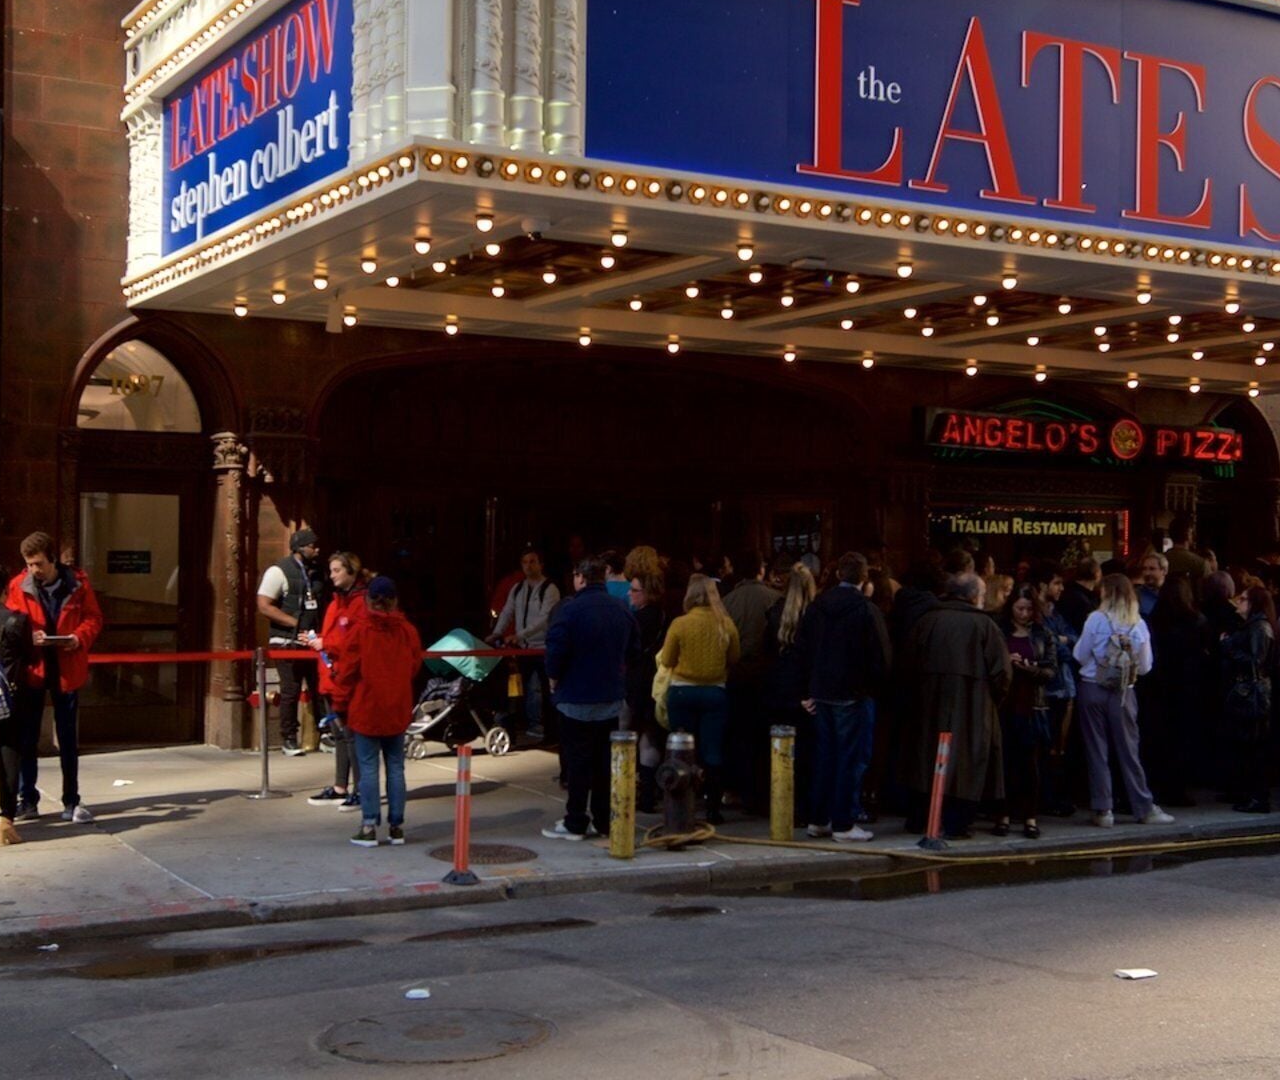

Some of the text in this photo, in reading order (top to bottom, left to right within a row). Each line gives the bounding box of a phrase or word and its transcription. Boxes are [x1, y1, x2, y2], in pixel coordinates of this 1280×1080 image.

[857, 65, 902, 104] the
[170, 58, 239, 170] LATE
[170, 89, 339, 241] stephen colbert
[109, 373, 164, 397] 1697
[941, 415, 1099, 453] ANGELO'S
[951, 517, 1106, 536] ITALIAN RESTAURANT
